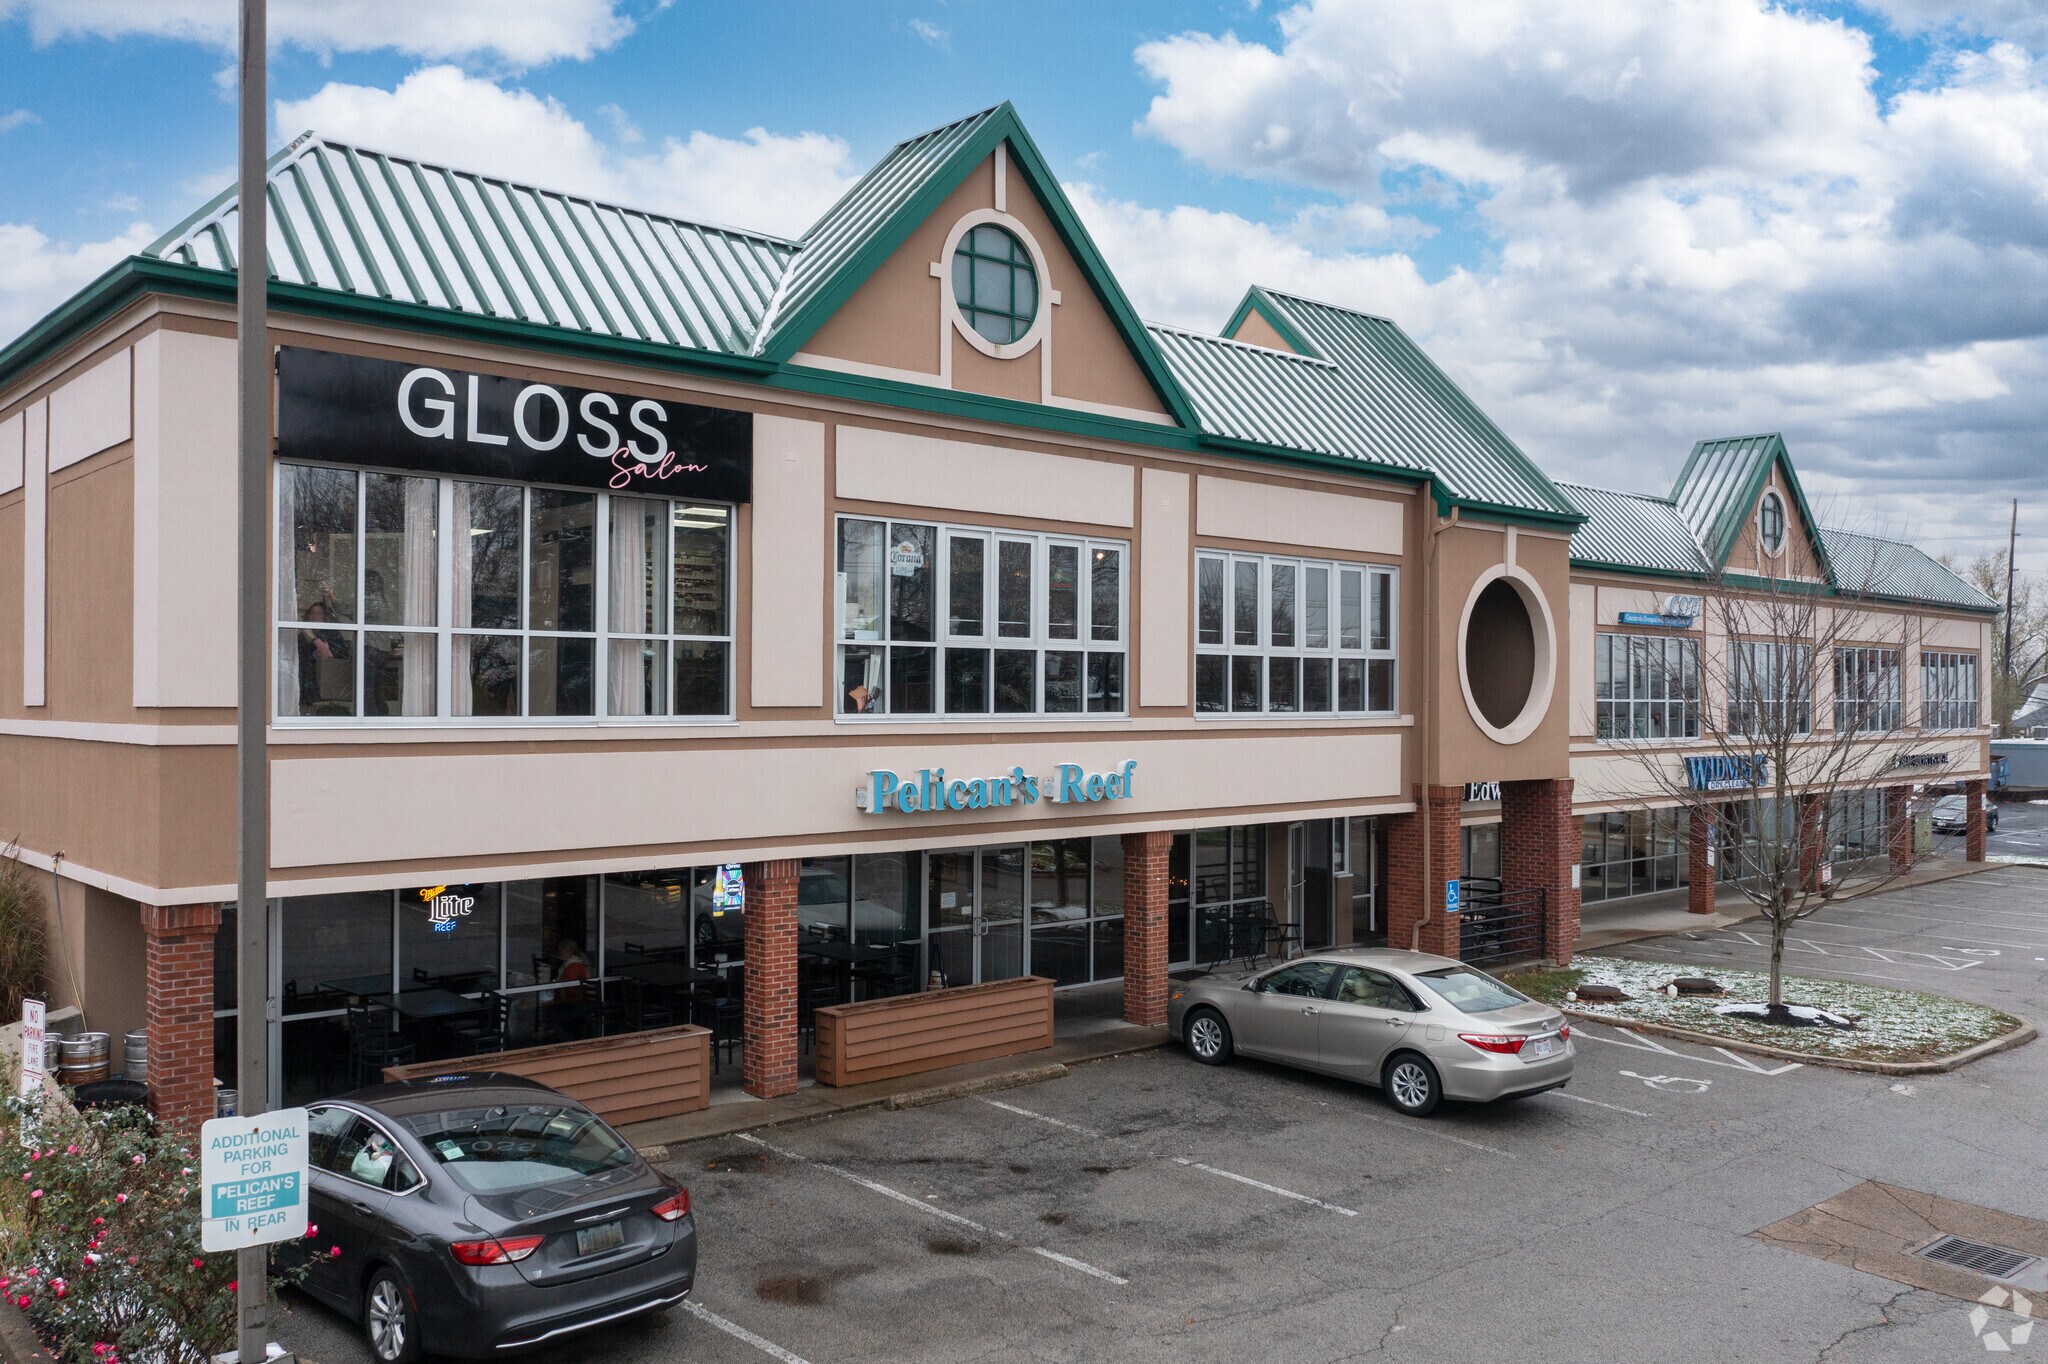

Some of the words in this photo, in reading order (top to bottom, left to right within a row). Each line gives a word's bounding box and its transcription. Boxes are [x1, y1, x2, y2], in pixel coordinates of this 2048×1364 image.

[398, 367, 668, 463] GLOSS
[609, 446, 708, 489] Salon
[891, 550, 921, 565] Corona
[866, 766, 1041, 814] Pelican's
[1051, 758, 1138, 804] Reef
[428, 895, 475, 924] Lite
[435, 921, 456, 931] REEF
[29, 1009, 39, 1024] NO
[24, 1025, 43, 1042] PARKING
[28, 1042, 38, 1054] FIRE
[27, 1056, 39, 1067] LANE
[211, 1127, 300, 1150] ADDITIONAL
[224, 1143, 288, 1163] PARKING
[241, 1160, 272, 1176] FOR
[217, 1176, 294, 1200] PELICAN'S
[237, 1194, 276, 1212] REEF
[225, 1219, 240, 1232] IN
[247, 1211, 287, 1229] REAR
